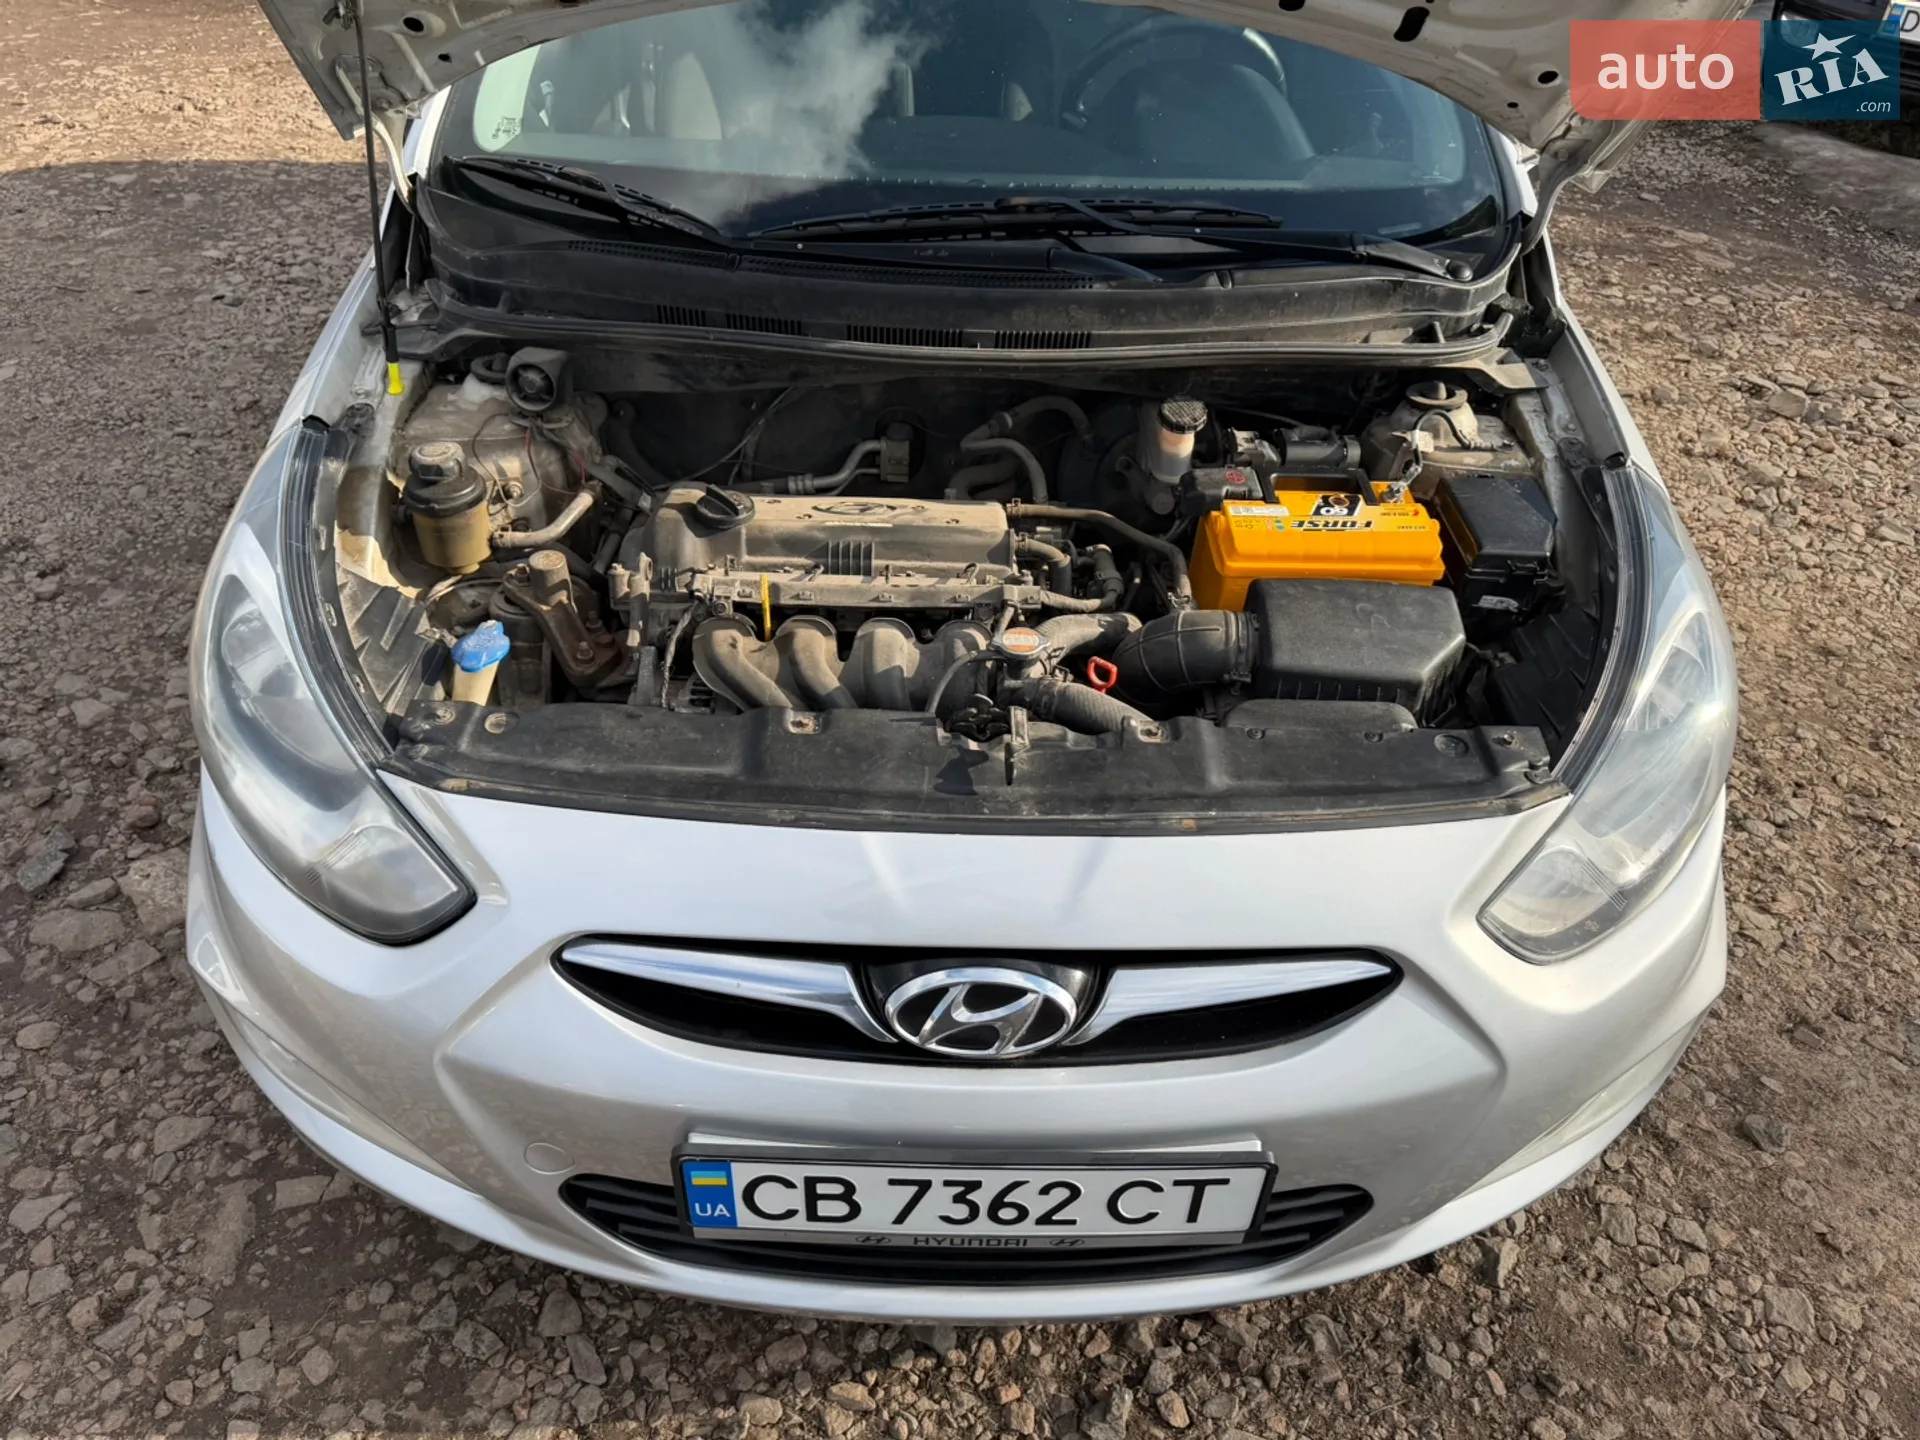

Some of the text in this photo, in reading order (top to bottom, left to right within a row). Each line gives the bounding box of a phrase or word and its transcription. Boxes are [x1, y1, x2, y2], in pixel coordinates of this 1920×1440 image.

[1290, 520, 1373, 529] FORSE
[741, 1174, 1231, 1226] CB 7362 CT
[694, 1202, 731, 1217] UA
[913, 1236, 1028, 1248] HYUNDAI
